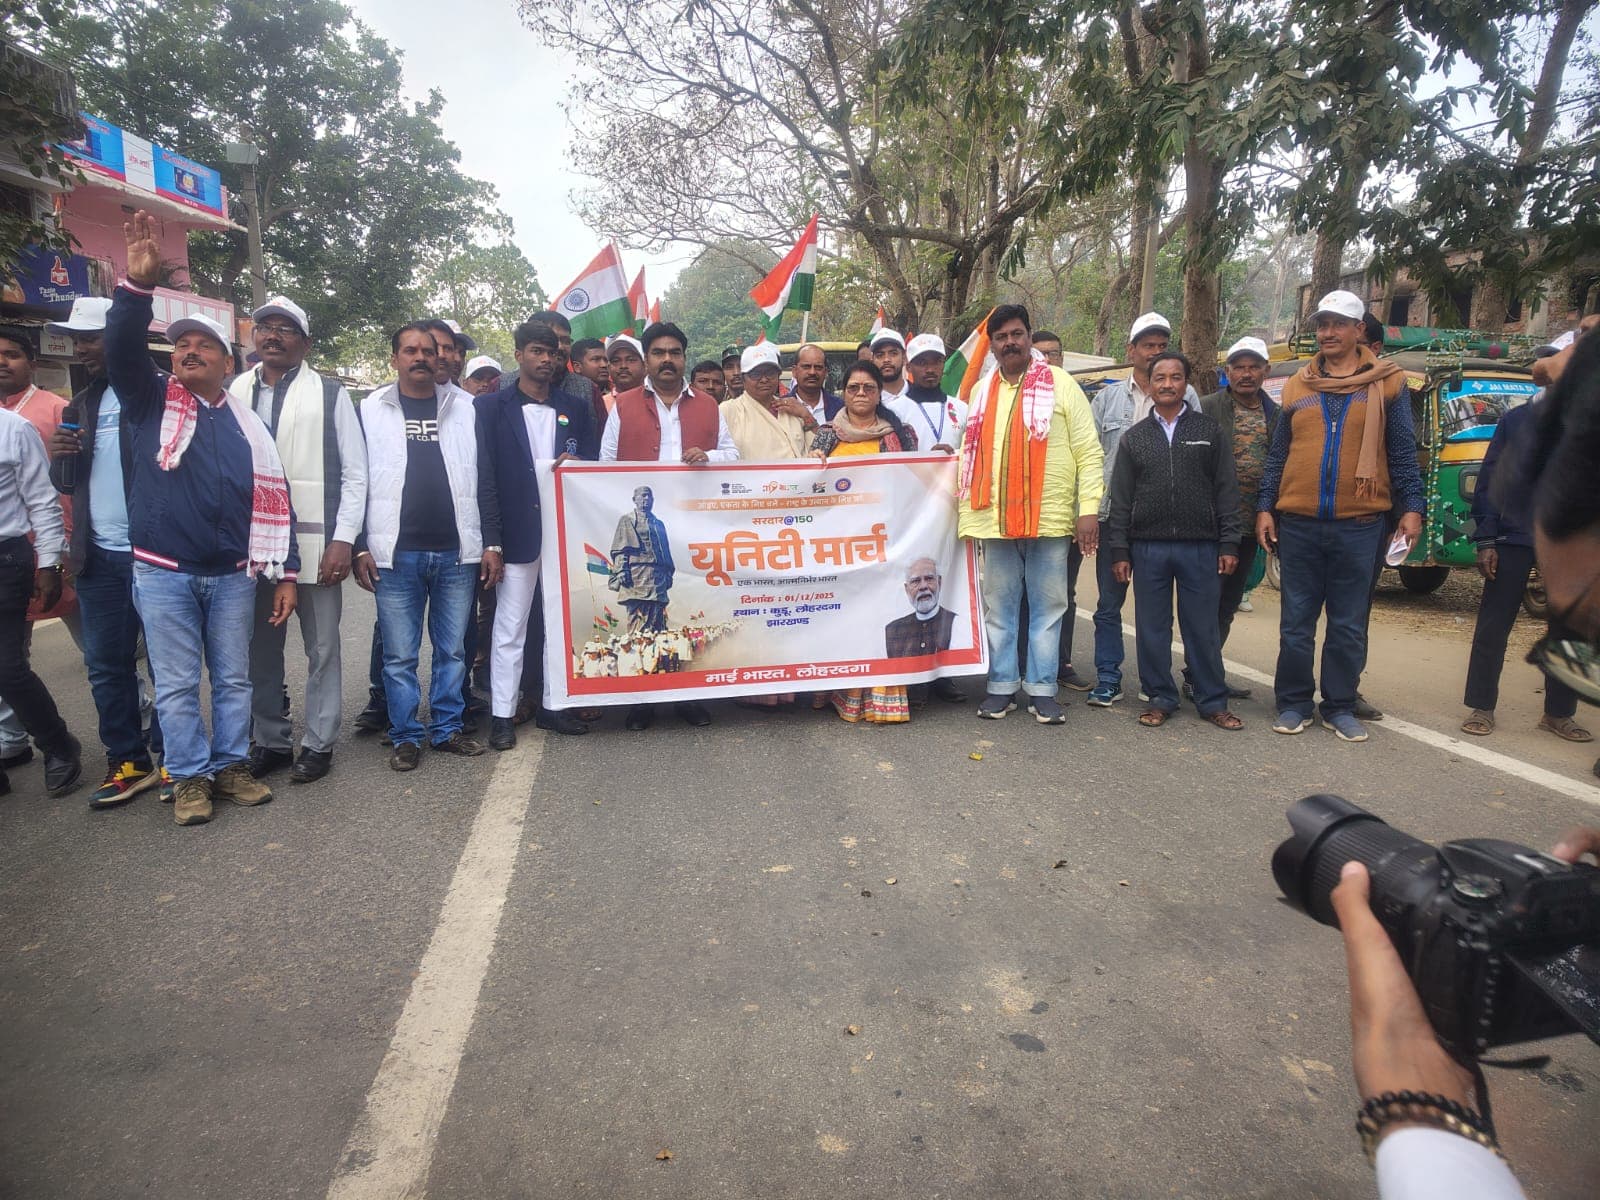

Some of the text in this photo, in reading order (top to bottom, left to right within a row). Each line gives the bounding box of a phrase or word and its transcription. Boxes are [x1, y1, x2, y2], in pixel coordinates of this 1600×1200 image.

[1489, 383, 1502, 391] JAI
[1502, 383, 1525, 391] MATA
[752, 515, 813, 525] सरदार@150
[688, 523, 888, 586] यूनिटी मार्च
[817, 575, 838, 583] भारत
[741, 594, 775, 604] दिनांक
[784, 592, 835, 602] 01/12/2025
[733, 608, 760, 617] स्थान
[795, 603, 841, 613] लोहरदगा
[766, 617, 810, 627] झारखण्ड
[705, 668, 738, 683] माई
[796, 663, 871, 678] लोहरदगा
